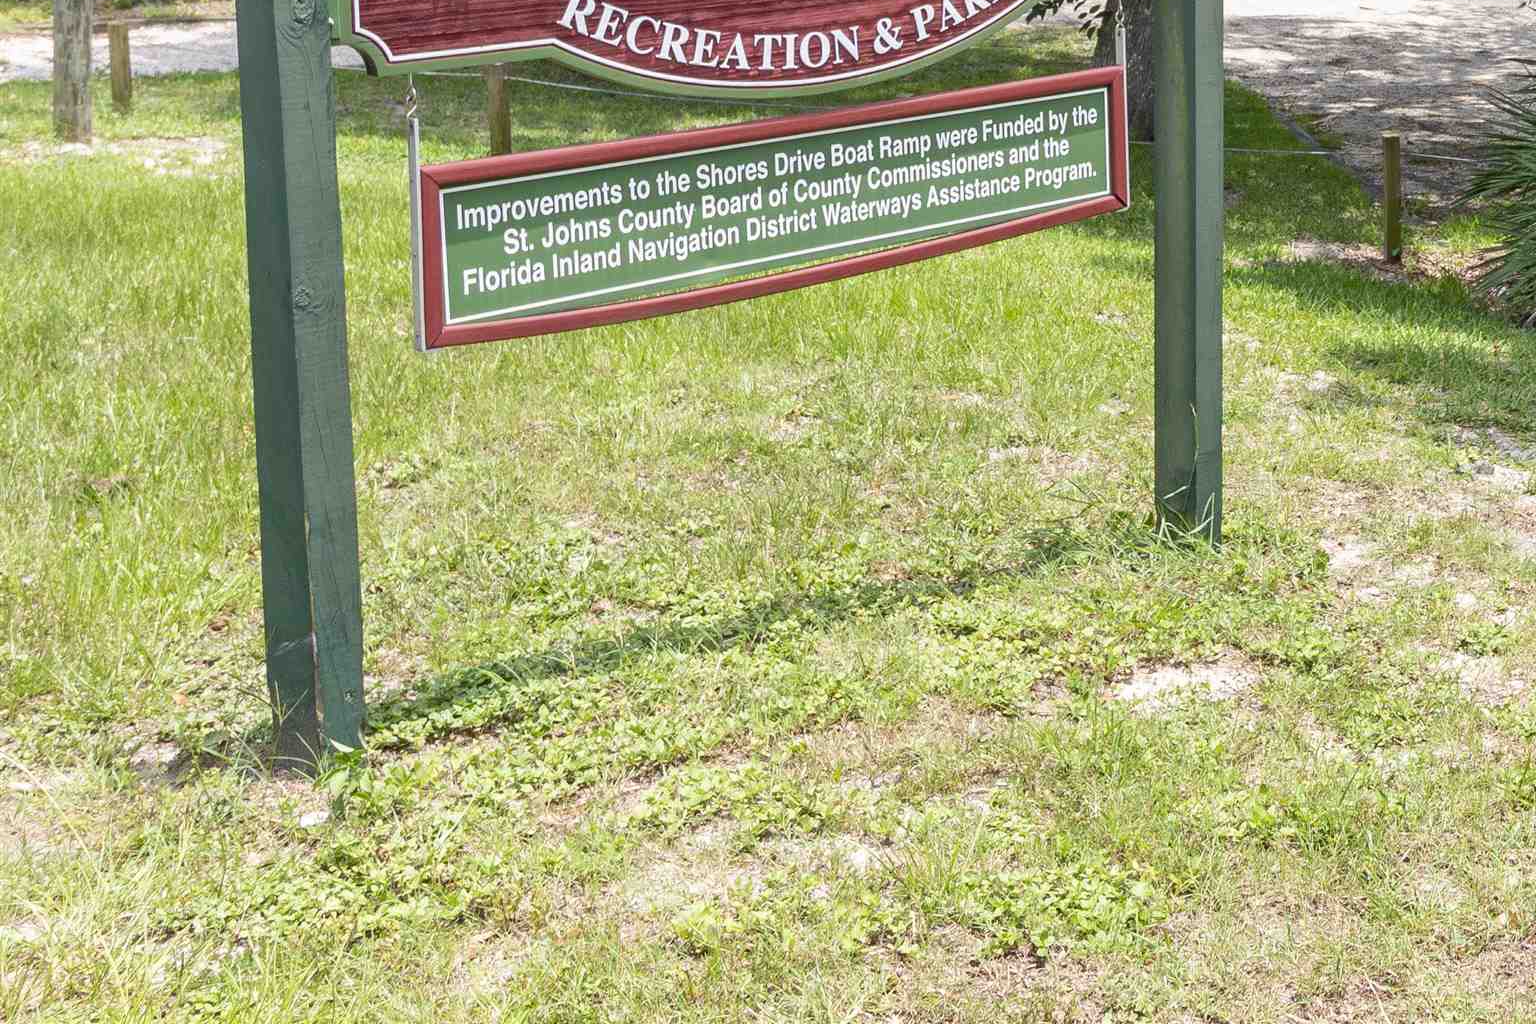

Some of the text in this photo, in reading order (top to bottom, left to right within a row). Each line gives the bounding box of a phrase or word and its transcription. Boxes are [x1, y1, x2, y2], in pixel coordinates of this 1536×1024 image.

[873, 17, 902, 54] &
[456, 106, 1098, 231] Improvements to the Shores Drive Boat Ramp were Funded by the
[463, 160, 1097, 295] Florida Inland Navigation District Waterways Assistance Program.
[503, 138, 1069, 255] St. Johns County Board of County Commissioners and the
